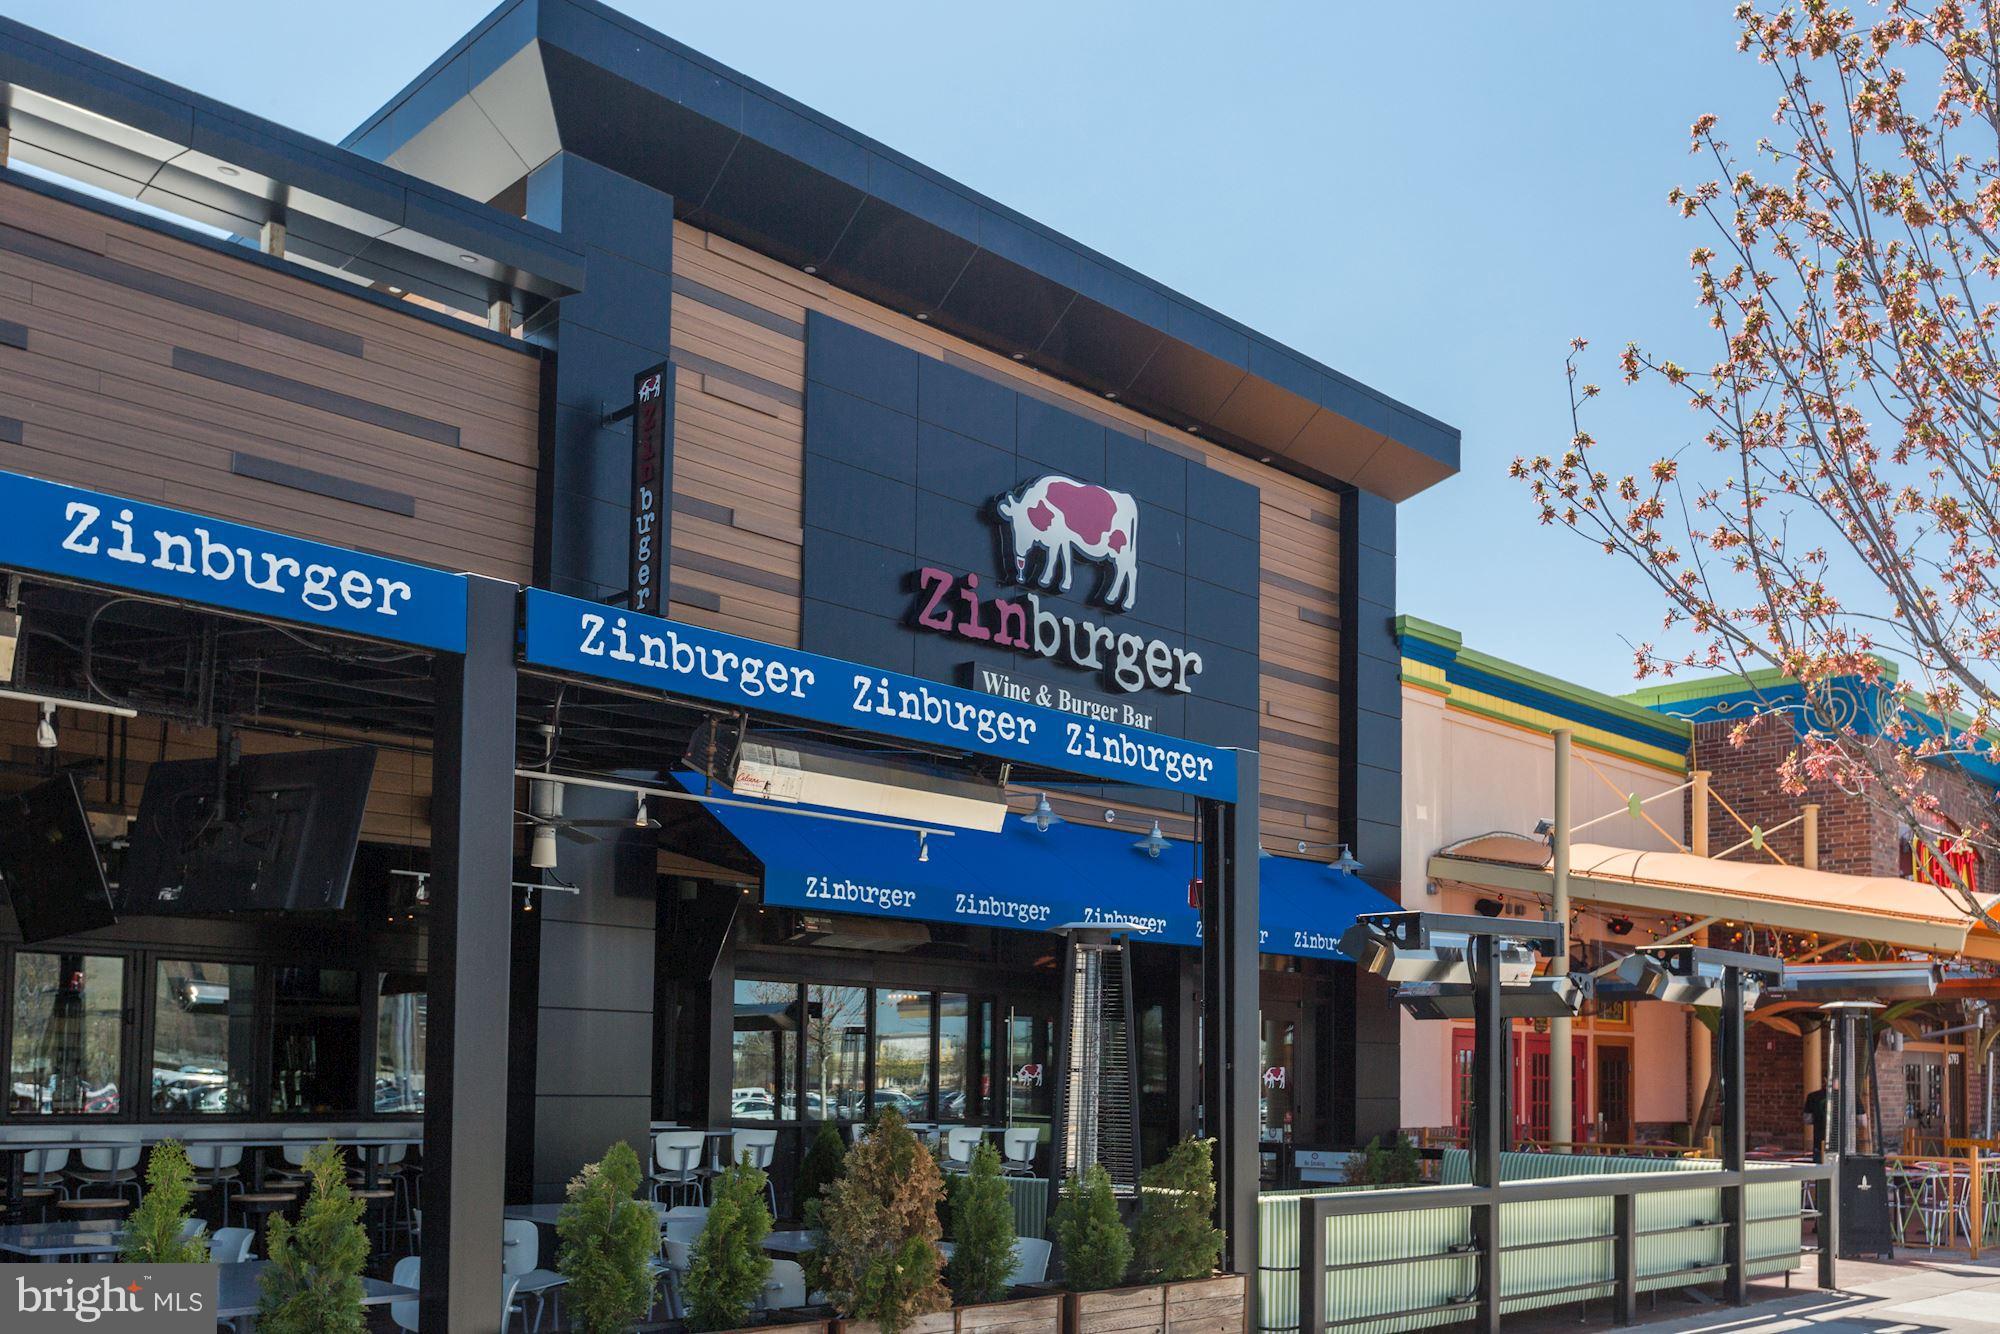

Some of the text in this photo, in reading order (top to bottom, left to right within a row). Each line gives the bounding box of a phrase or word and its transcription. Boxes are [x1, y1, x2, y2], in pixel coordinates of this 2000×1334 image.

[62, 501, 412, 616] Zinburger
[918, 566, 1203, 693] Zinburger
[579, 612, 1213, 783] Zinburger Zinburger Zinburger
[982, 670, 1153, 730] Wine & Burger Bar
[806, 876, 916, 909] Zinburger
[955, 893, 1050, 923] Zinburger
